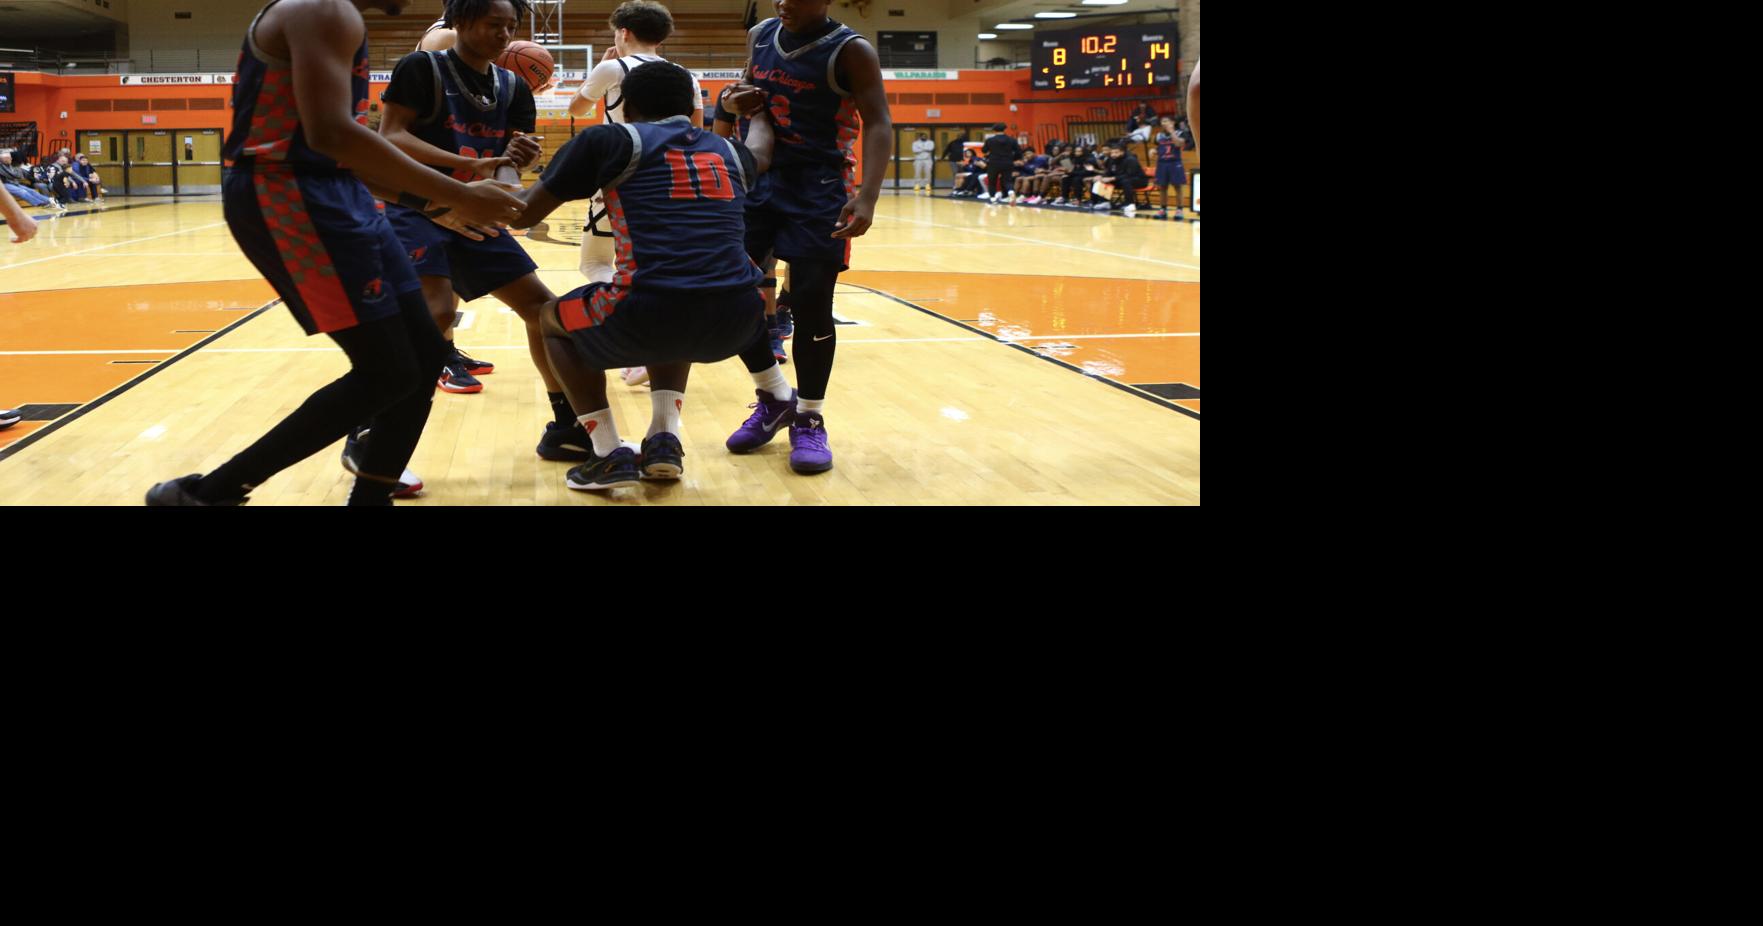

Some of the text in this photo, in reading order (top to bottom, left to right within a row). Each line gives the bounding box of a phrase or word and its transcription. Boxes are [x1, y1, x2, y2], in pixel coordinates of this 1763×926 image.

[1081, 35, 1117, 54] 10.2
[1150, 42, 1170, 61] 14
[1053, 48, 1067, 66] 8
[703, 71, 742, 79] MICHIGA
[1054, 75, 1066, 89] 5
[664, 148, 736, 202] 10
